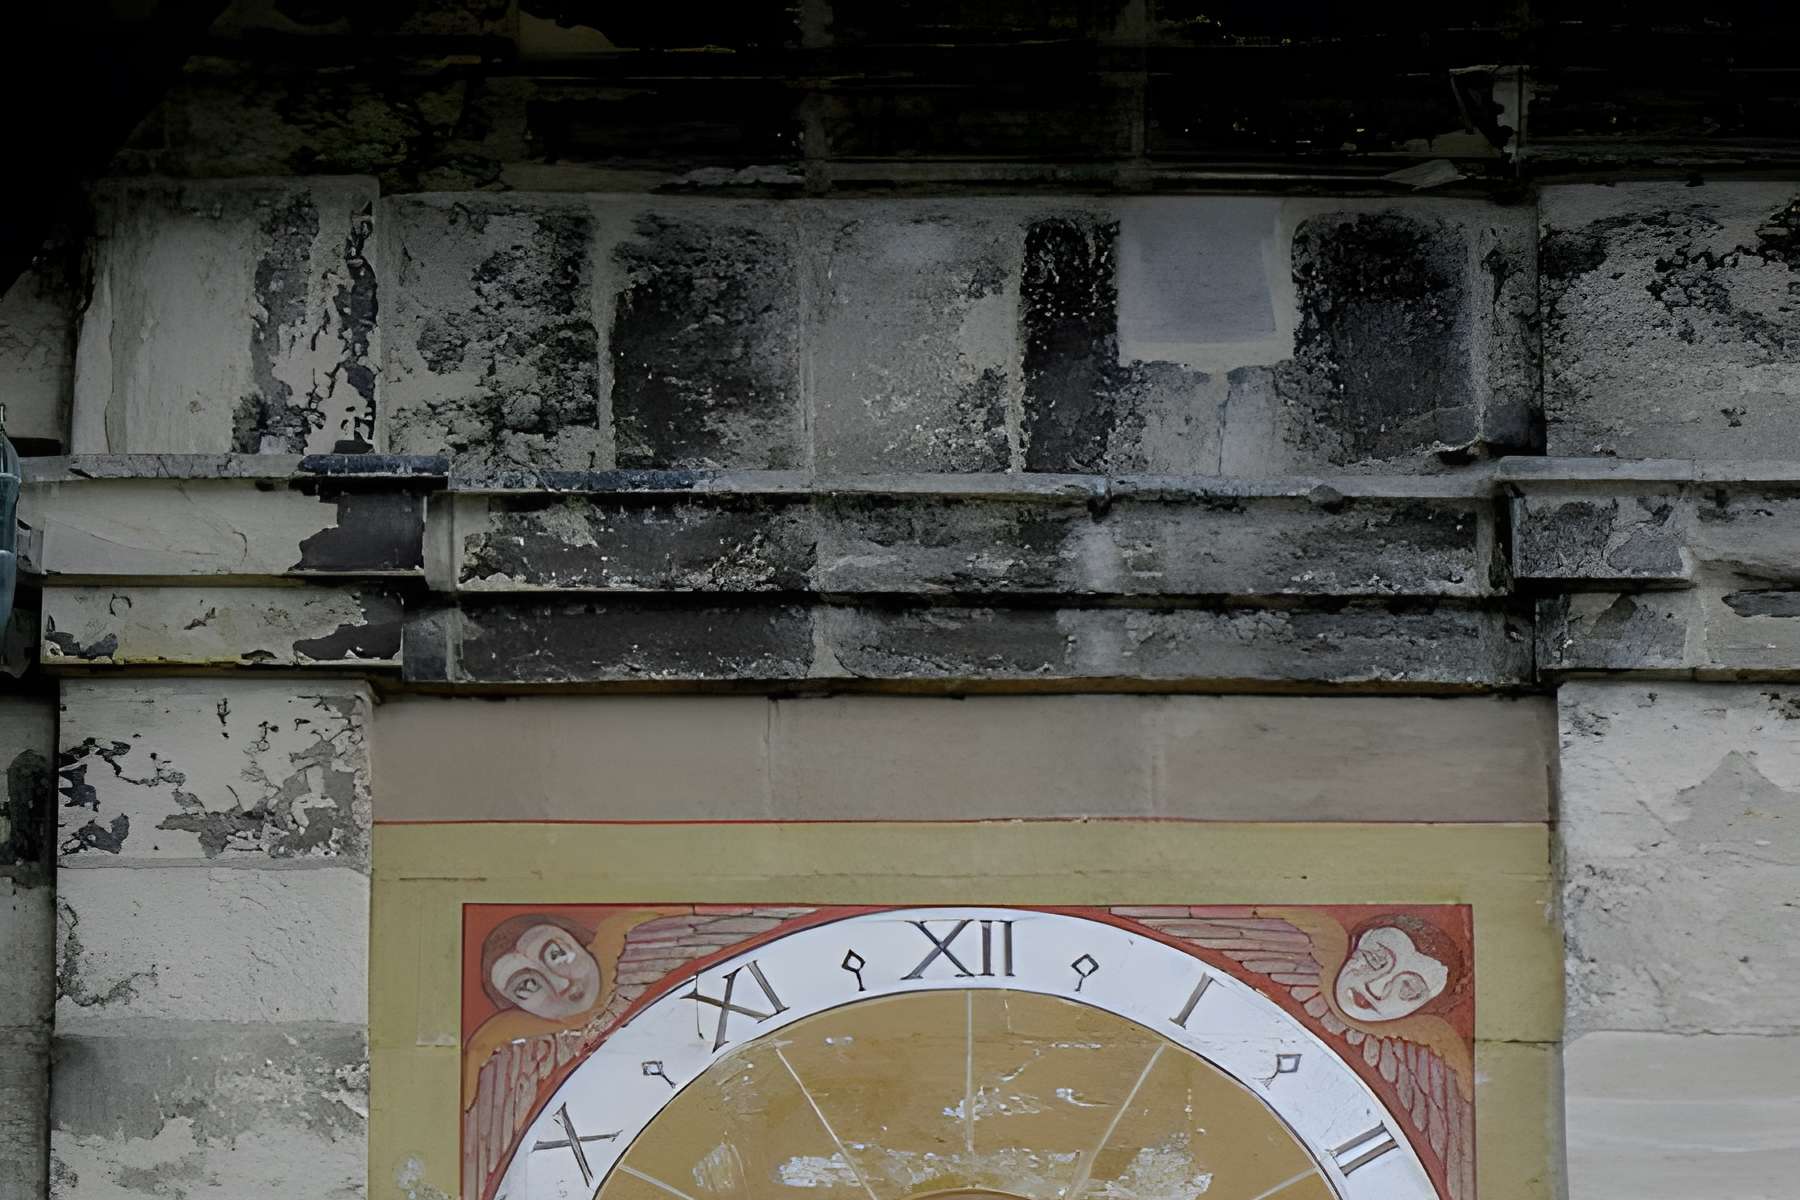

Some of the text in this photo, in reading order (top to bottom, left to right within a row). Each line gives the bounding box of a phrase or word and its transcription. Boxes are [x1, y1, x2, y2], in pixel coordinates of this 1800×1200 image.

[900, 918, 1016, 981] XII
[680, 960, 791, 1053] XI
[1169, 972, 1217, 1029] I
[533, 1102, 623, 1188] X
[1328, 1120, 1401, 1177] II
